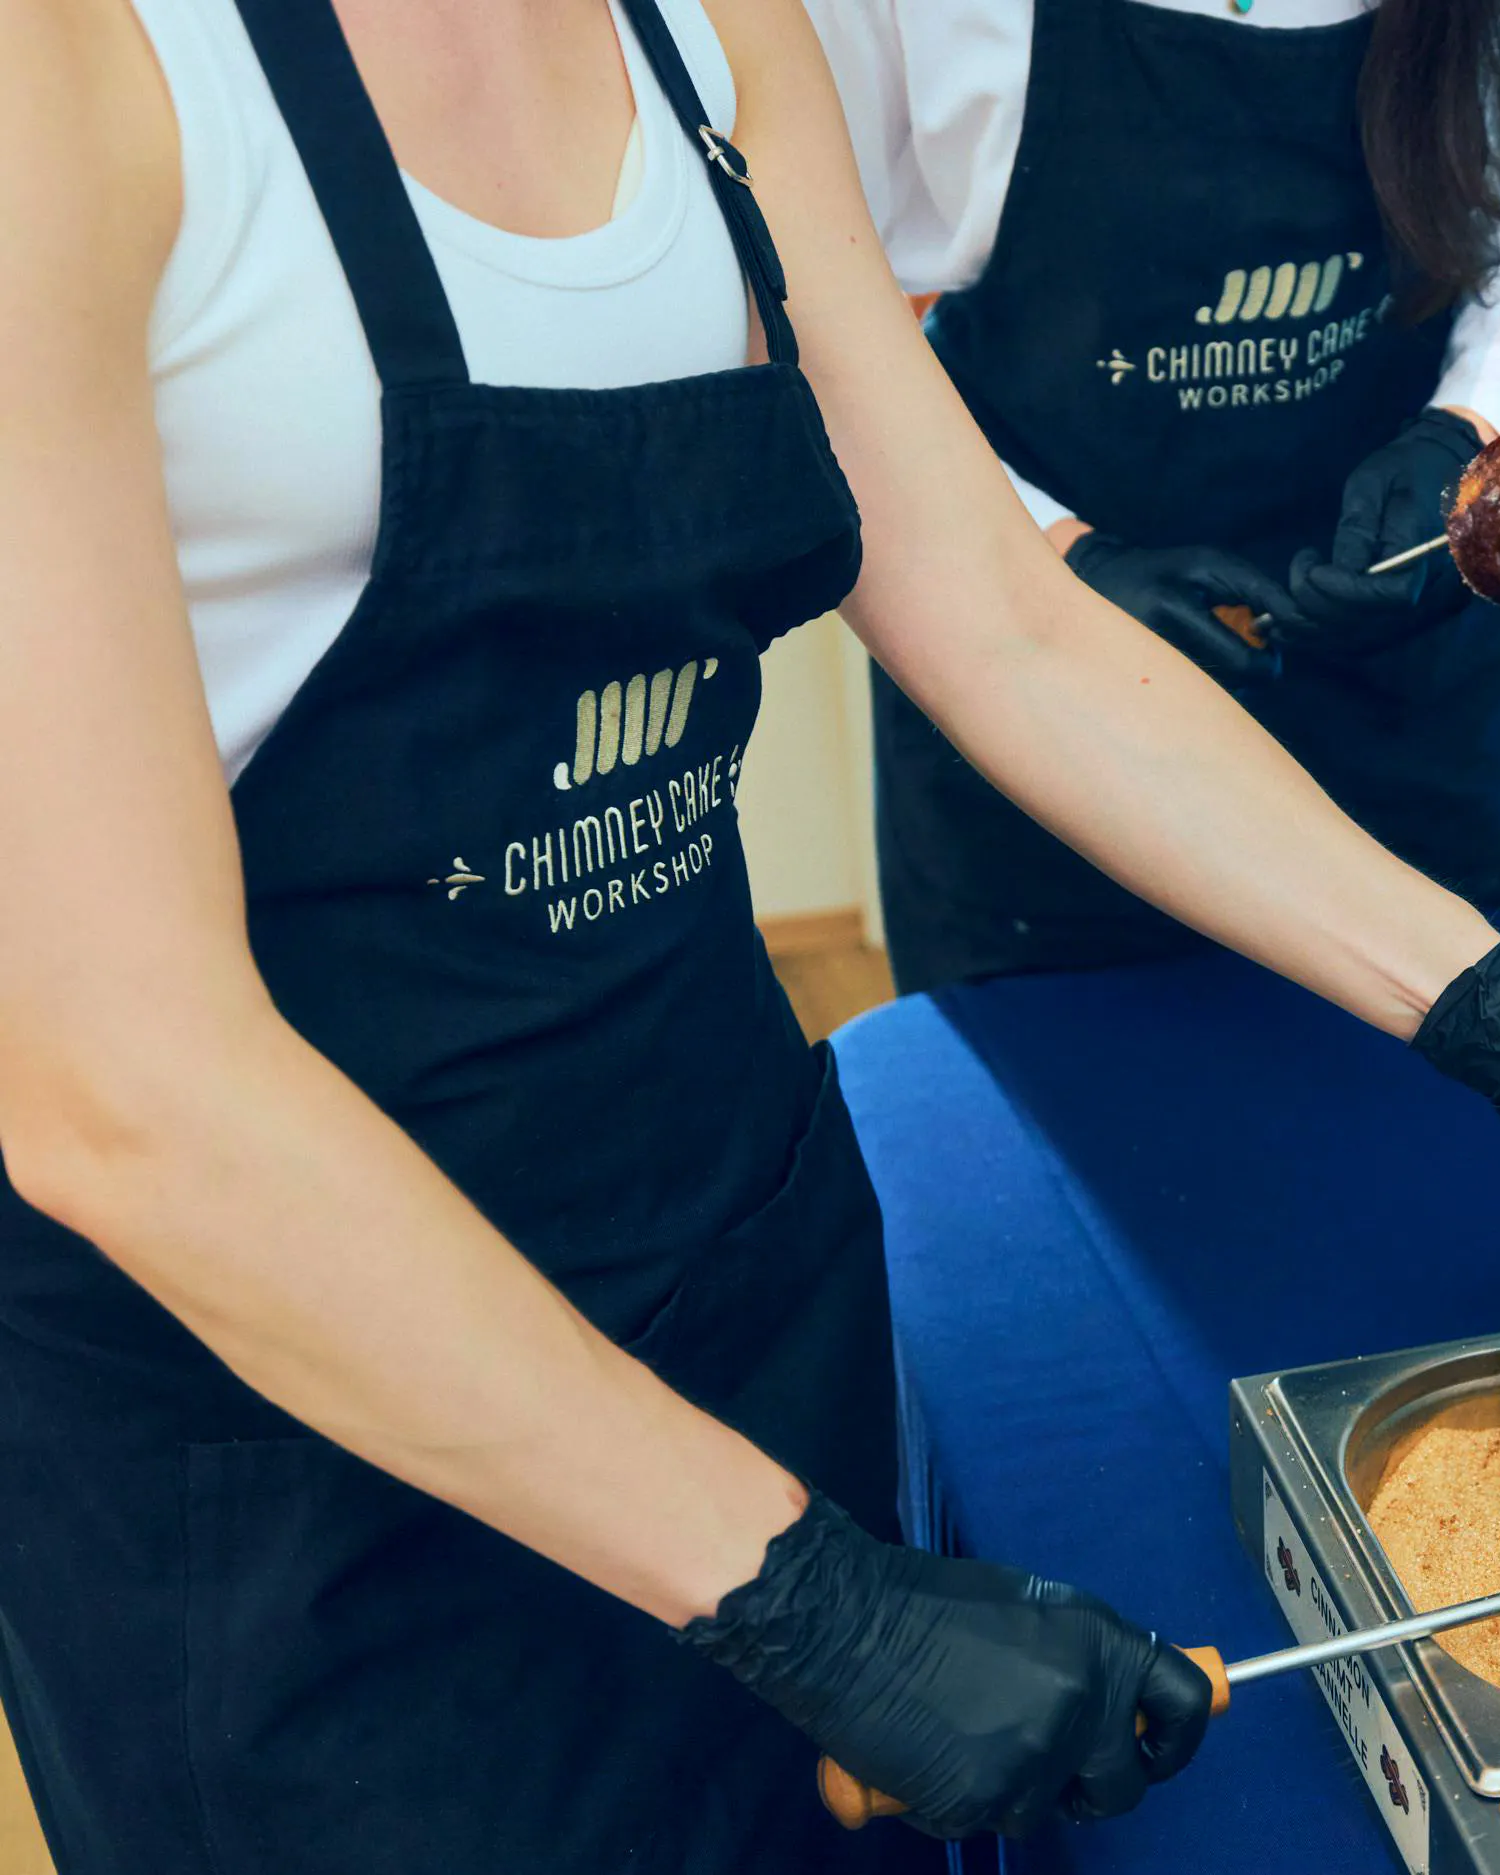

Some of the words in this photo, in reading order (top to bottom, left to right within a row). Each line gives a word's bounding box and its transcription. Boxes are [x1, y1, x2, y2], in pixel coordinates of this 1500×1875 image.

[1147, 338, 1299, 383] CHIMNEY
[1307, 308, 1371, 367] CAKE
[1178, 359, 1345, 410] WORKSHOP
[504, 790, 664, 896] CHIMNEY
[669, 755, 723, 833] CAKE
[548, 834, 713, 933] WORKSHOP
[1315, 1660, 1369, 1772] ANNELLE
